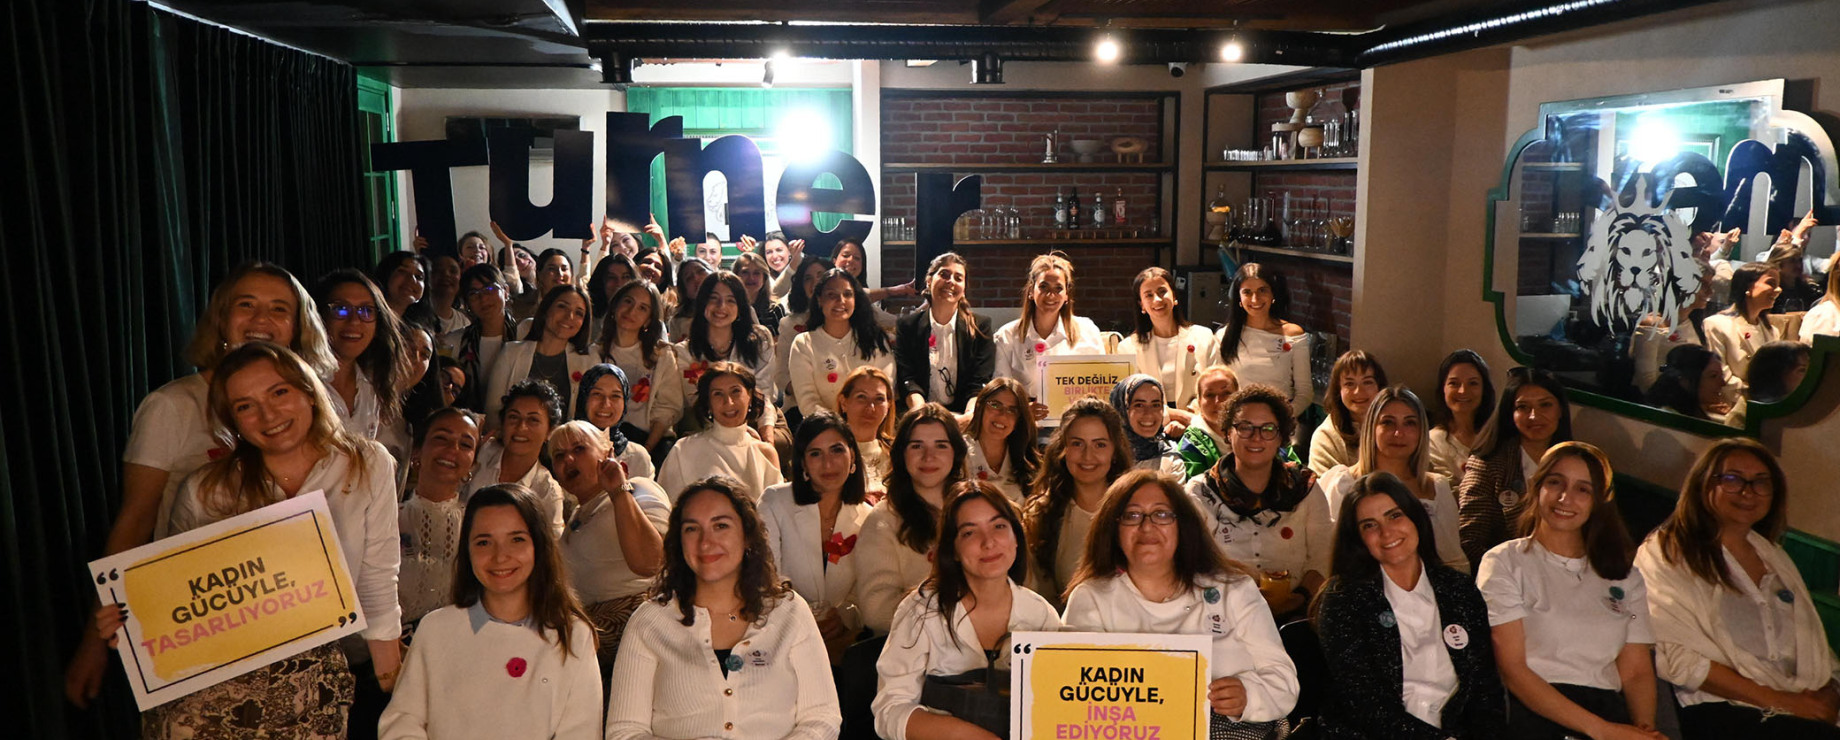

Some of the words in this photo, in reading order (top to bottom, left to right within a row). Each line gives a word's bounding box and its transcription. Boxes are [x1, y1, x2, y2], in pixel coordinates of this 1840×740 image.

[1055, 376, 1075, 385] TEK
[1077, 373, 1118, 384] DEĞİLİZ
[188, 556, 266, 596] KADIN
[171, 572, 296, 624] GÜCÜYLE,
[141, 580, 328, 658] TASARLIYORUZ
[1080, 667, 1144, 683] KADIN
[1059, 681, 1164, 704] GÜCÜYLE,
[1087, 701, 1137, 725] İNŞA
[1056, 721, 1161, 740] EDİYORUZ
